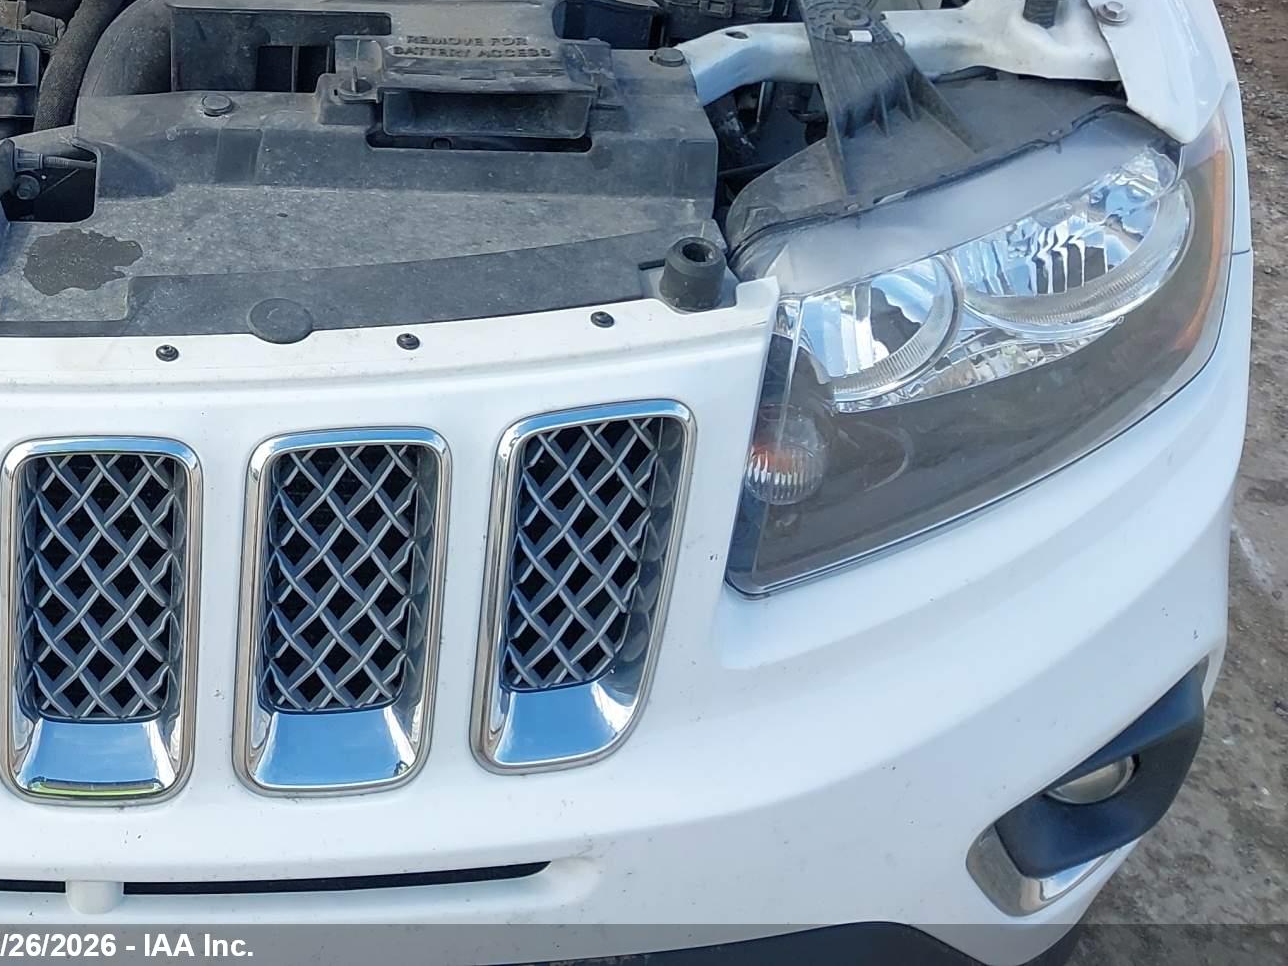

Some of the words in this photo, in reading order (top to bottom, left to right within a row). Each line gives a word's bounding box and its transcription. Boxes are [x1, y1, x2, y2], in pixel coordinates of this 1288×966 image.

[406, 35, 485, 47] REMOVE
[490, 37, 529, 47] FOR
[393, 46, 473, 58] BATTERY
[477, 46, 553, 58] ACCESS
